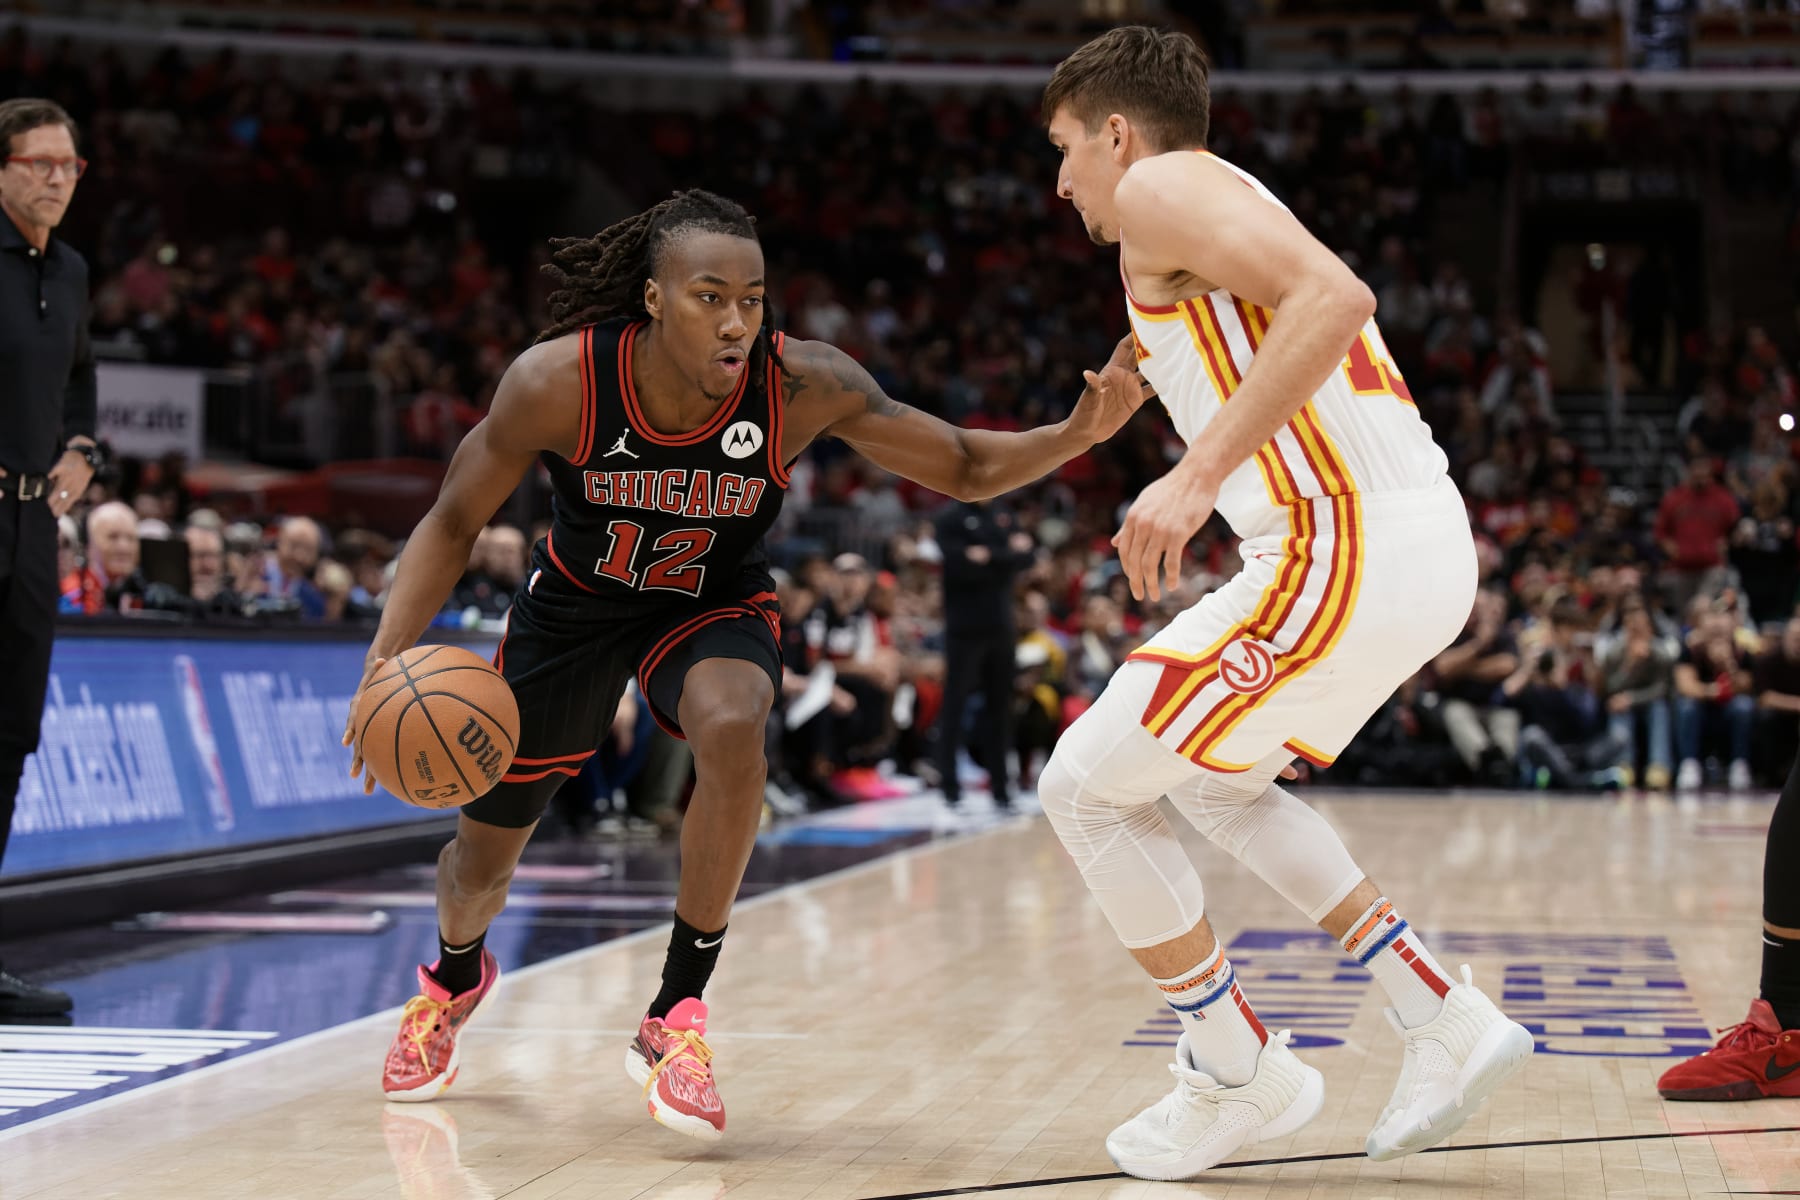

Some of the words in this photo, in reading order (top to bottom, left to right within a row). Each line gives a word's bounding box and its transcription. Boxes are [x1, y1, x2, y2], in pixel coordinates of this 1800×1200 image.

[583, 469, 766, 518] CHICAGO
[594, 520, 717, 598] 12
[1502, 962, 1713, 1057] CENTER
